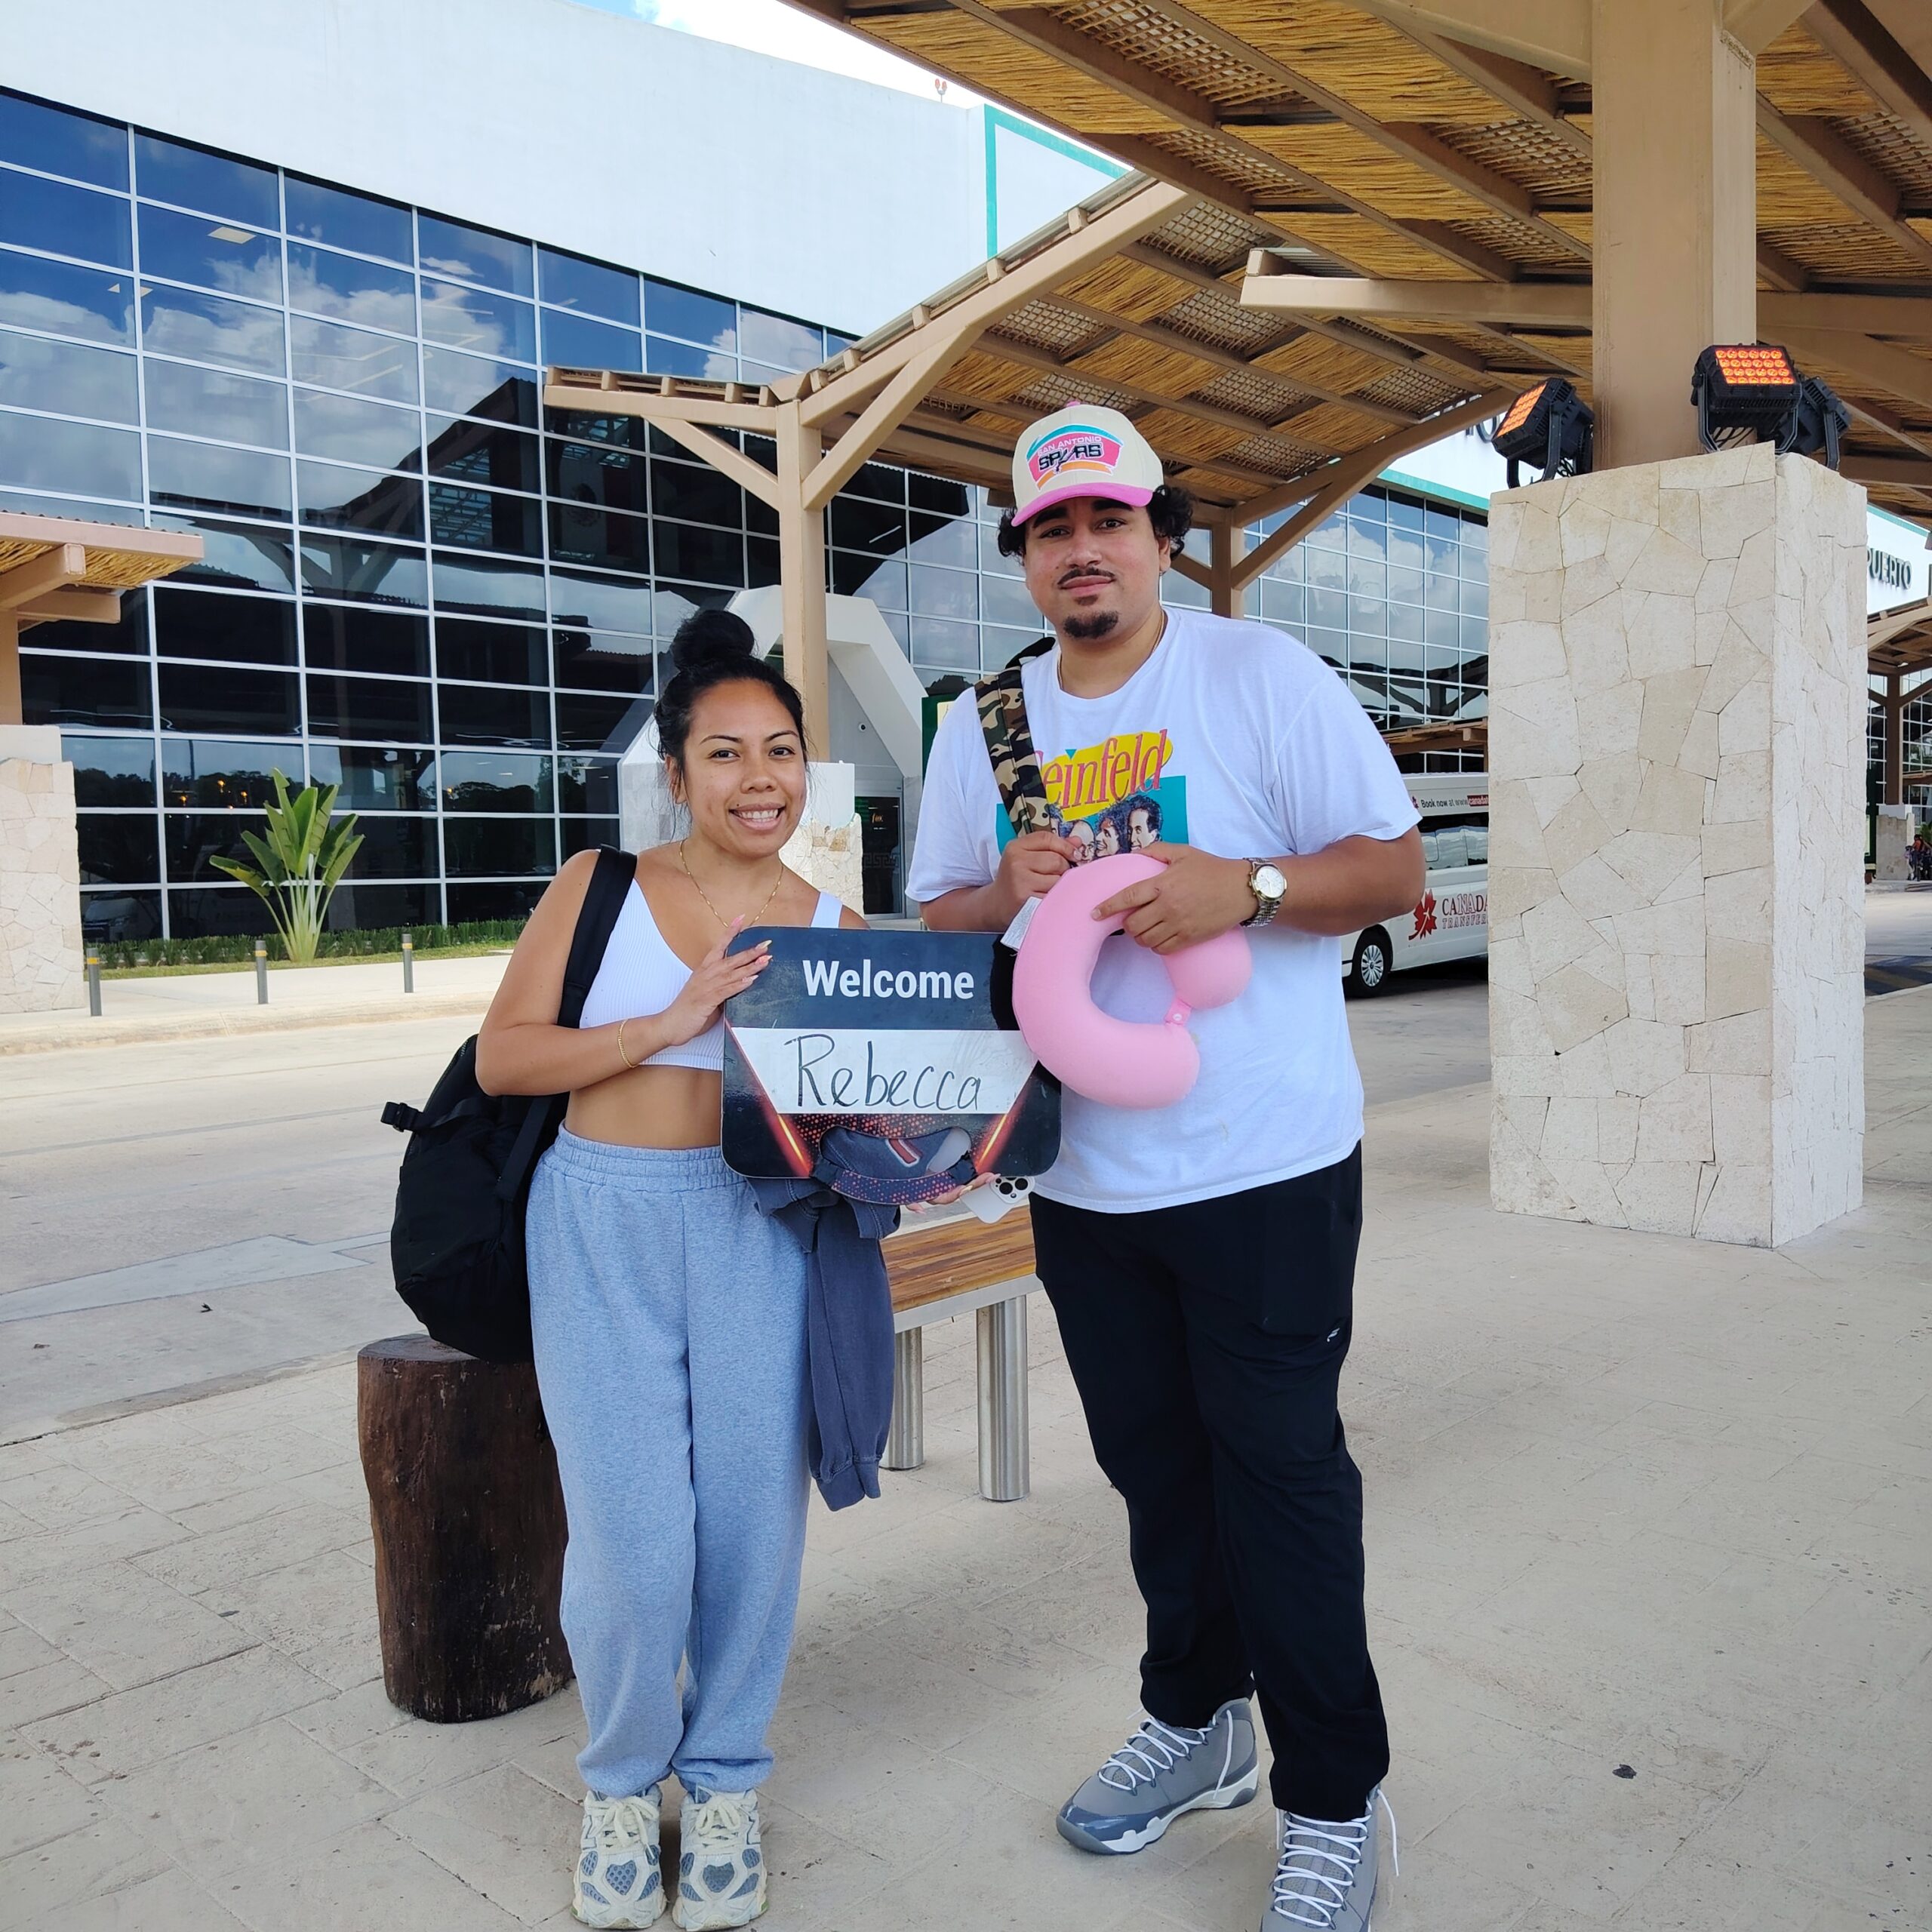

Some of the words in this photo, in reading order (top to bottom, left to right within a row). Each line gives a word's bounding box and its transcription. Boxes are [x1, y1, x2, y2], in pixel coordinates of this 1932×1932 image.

[1038, 445, 1056, 456] SAN
[1059, 436, 1102, 448] ANTONIO
[1035, 728, 1168, 810] einfeld
[1421, 799, 1435, 808] Book
[1448, 798, 1456, 807] at
[1442, 914, 1488, 929] TRANSFER
[802, 959, 974, 999] Welcome
[783, 1034, 981, 1111] Rebecca
